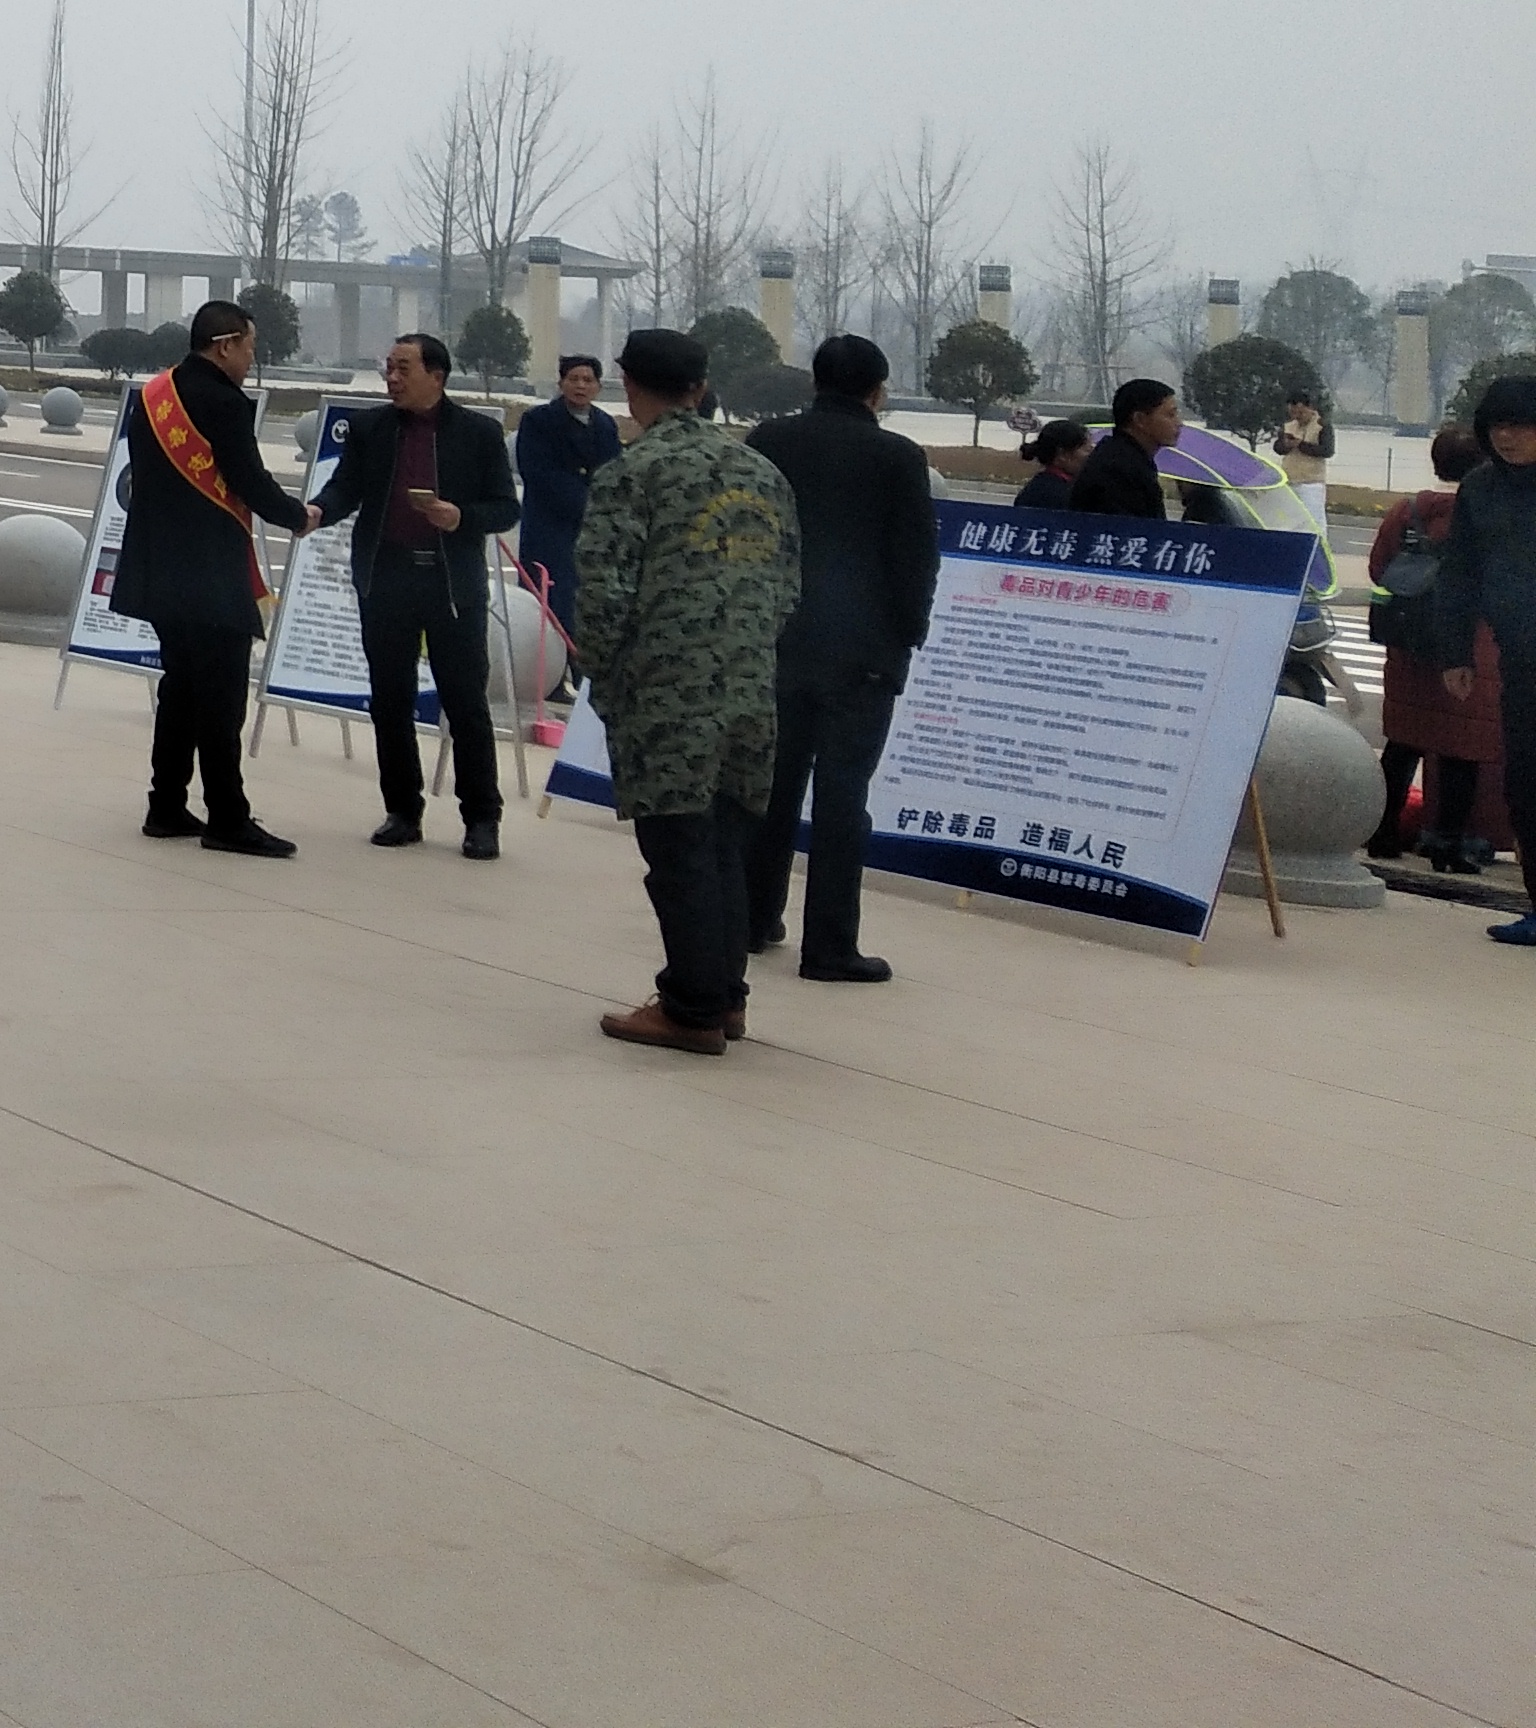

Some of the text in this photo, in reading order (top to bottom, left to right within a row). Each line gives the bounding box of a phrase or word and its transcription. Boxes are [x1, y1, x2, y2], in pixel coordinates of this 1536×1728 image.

[959, 520, 1216, 575] 健康无毒 蒸爱有你
[999, 573, 1174, 613] 毒品对青少年的危害
[897, 806, 1128, 870] 铲除毒品 造福人民
